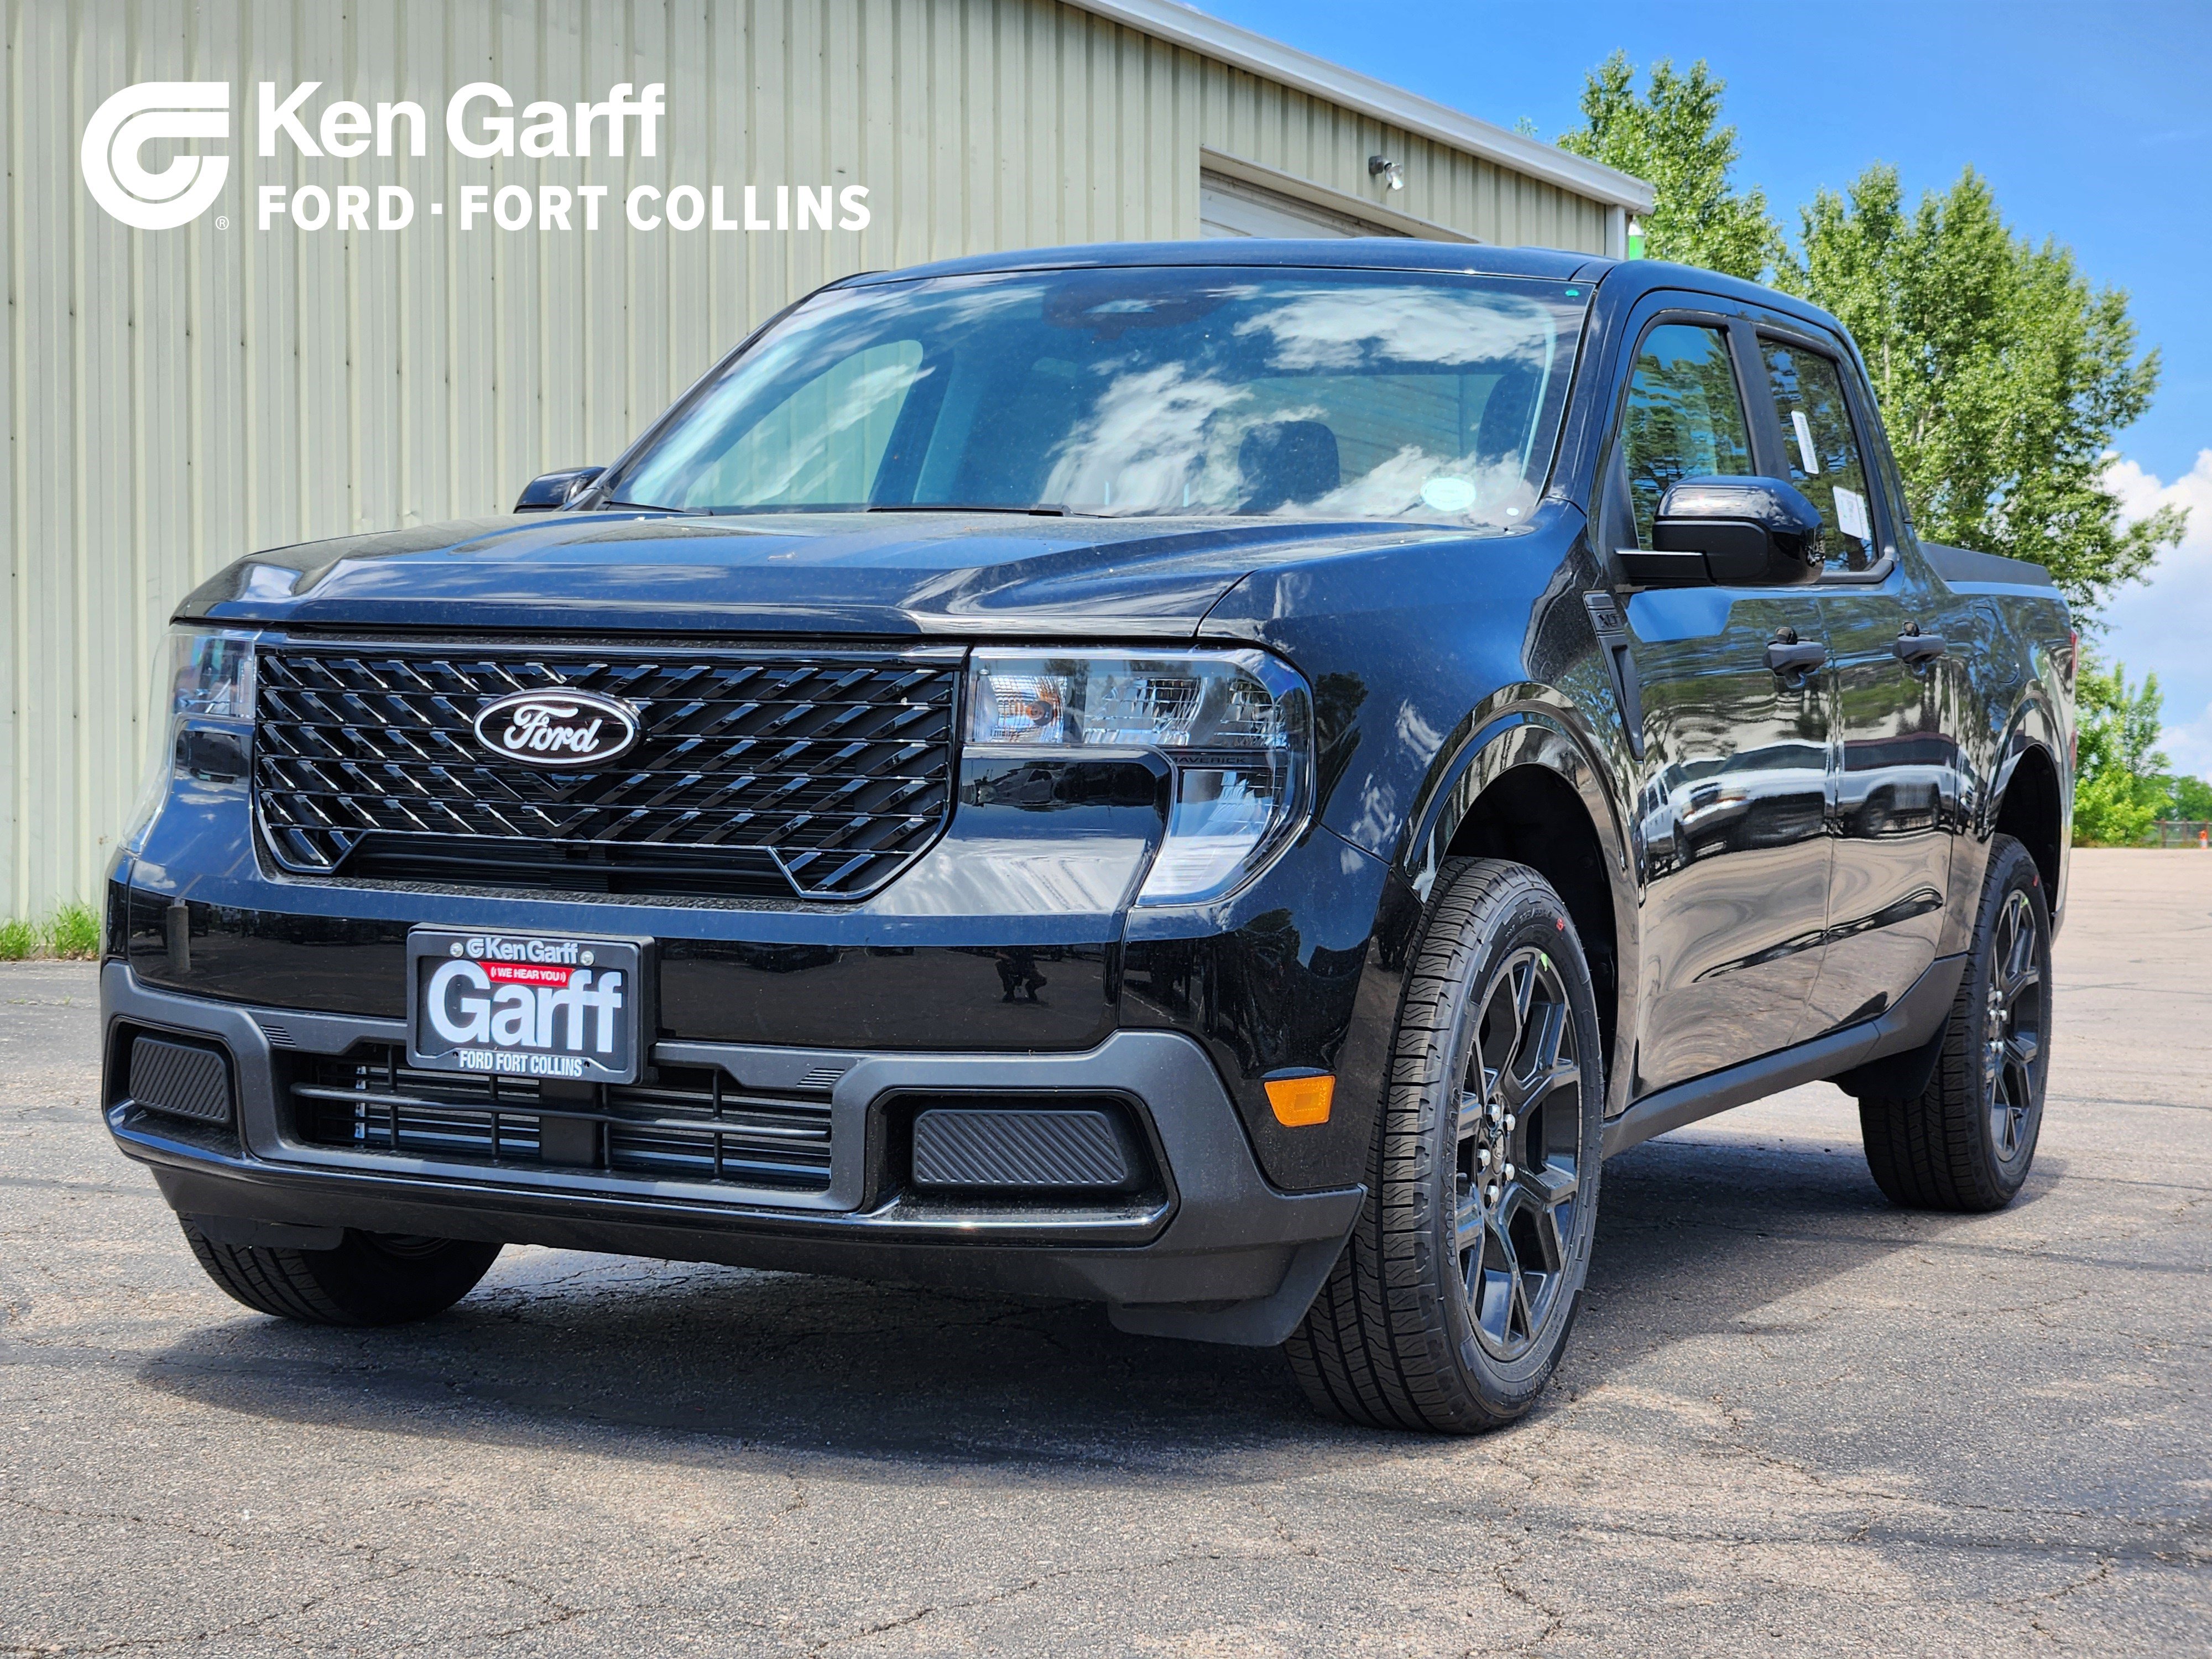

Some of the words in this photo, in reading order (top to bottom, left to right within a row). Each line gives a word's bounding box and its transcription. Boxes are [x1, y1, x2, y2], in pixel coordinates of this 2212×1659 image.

[503, 704, 603, 753] Ford
[486, 937, 526, 961] Ken
[527, 941, 578, 964] Garff
[498, 968, 513, 978] WE
[513, 969, 540, 980] HEAR
[540, 971, 561, 982] YOU
[428, 959, 622, 1053] Garff
[459, 1050, 493, 1070] FORD
[495, 1053, 529, 1072] FORT
[530, 1056, 583, 1077] COLLINS
